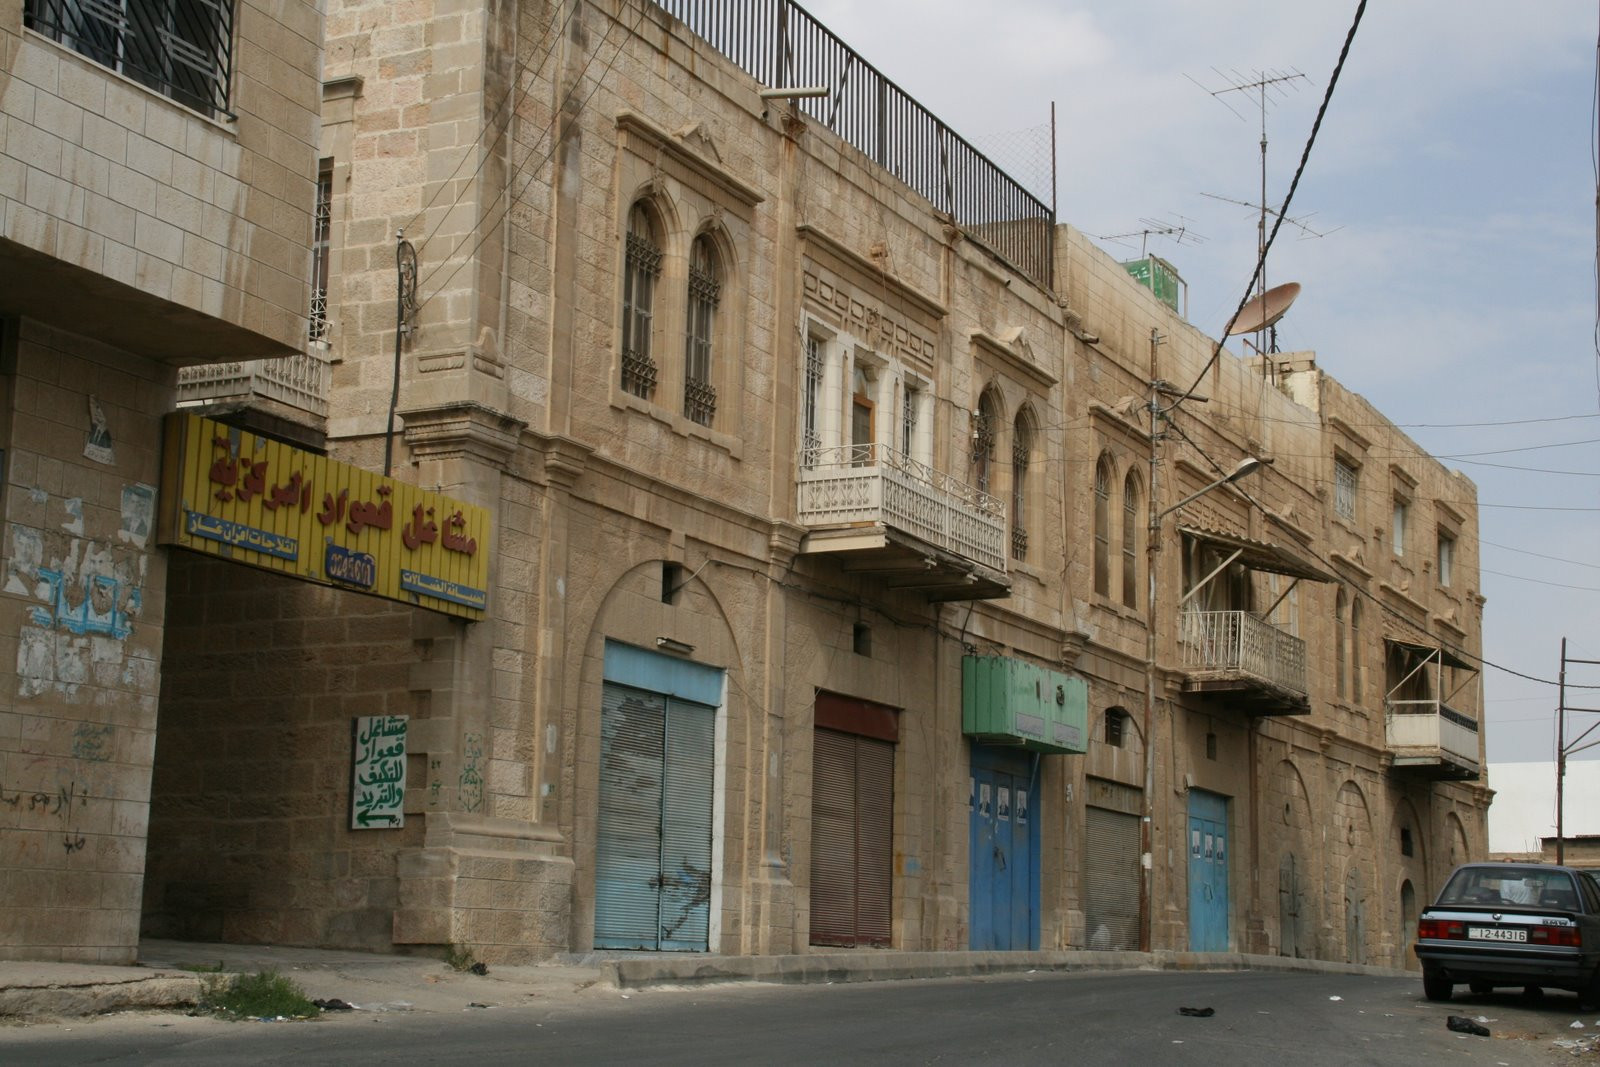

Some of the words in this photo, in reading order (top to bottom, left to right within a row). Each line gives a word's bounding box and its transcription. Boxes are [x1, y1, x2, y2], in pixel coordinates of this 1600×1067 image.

[208, 436, 312, 515] المركزية
[191, 513, 224, 534] غاز
[316, 485, 393, 534] قعوار
[402, 502, 477, 556] مشاغل
[360, 716, 407, 745] مشاغل
[356, 736, 405, 765] قعوار
[356, 782, 403, 811] والتبريد
